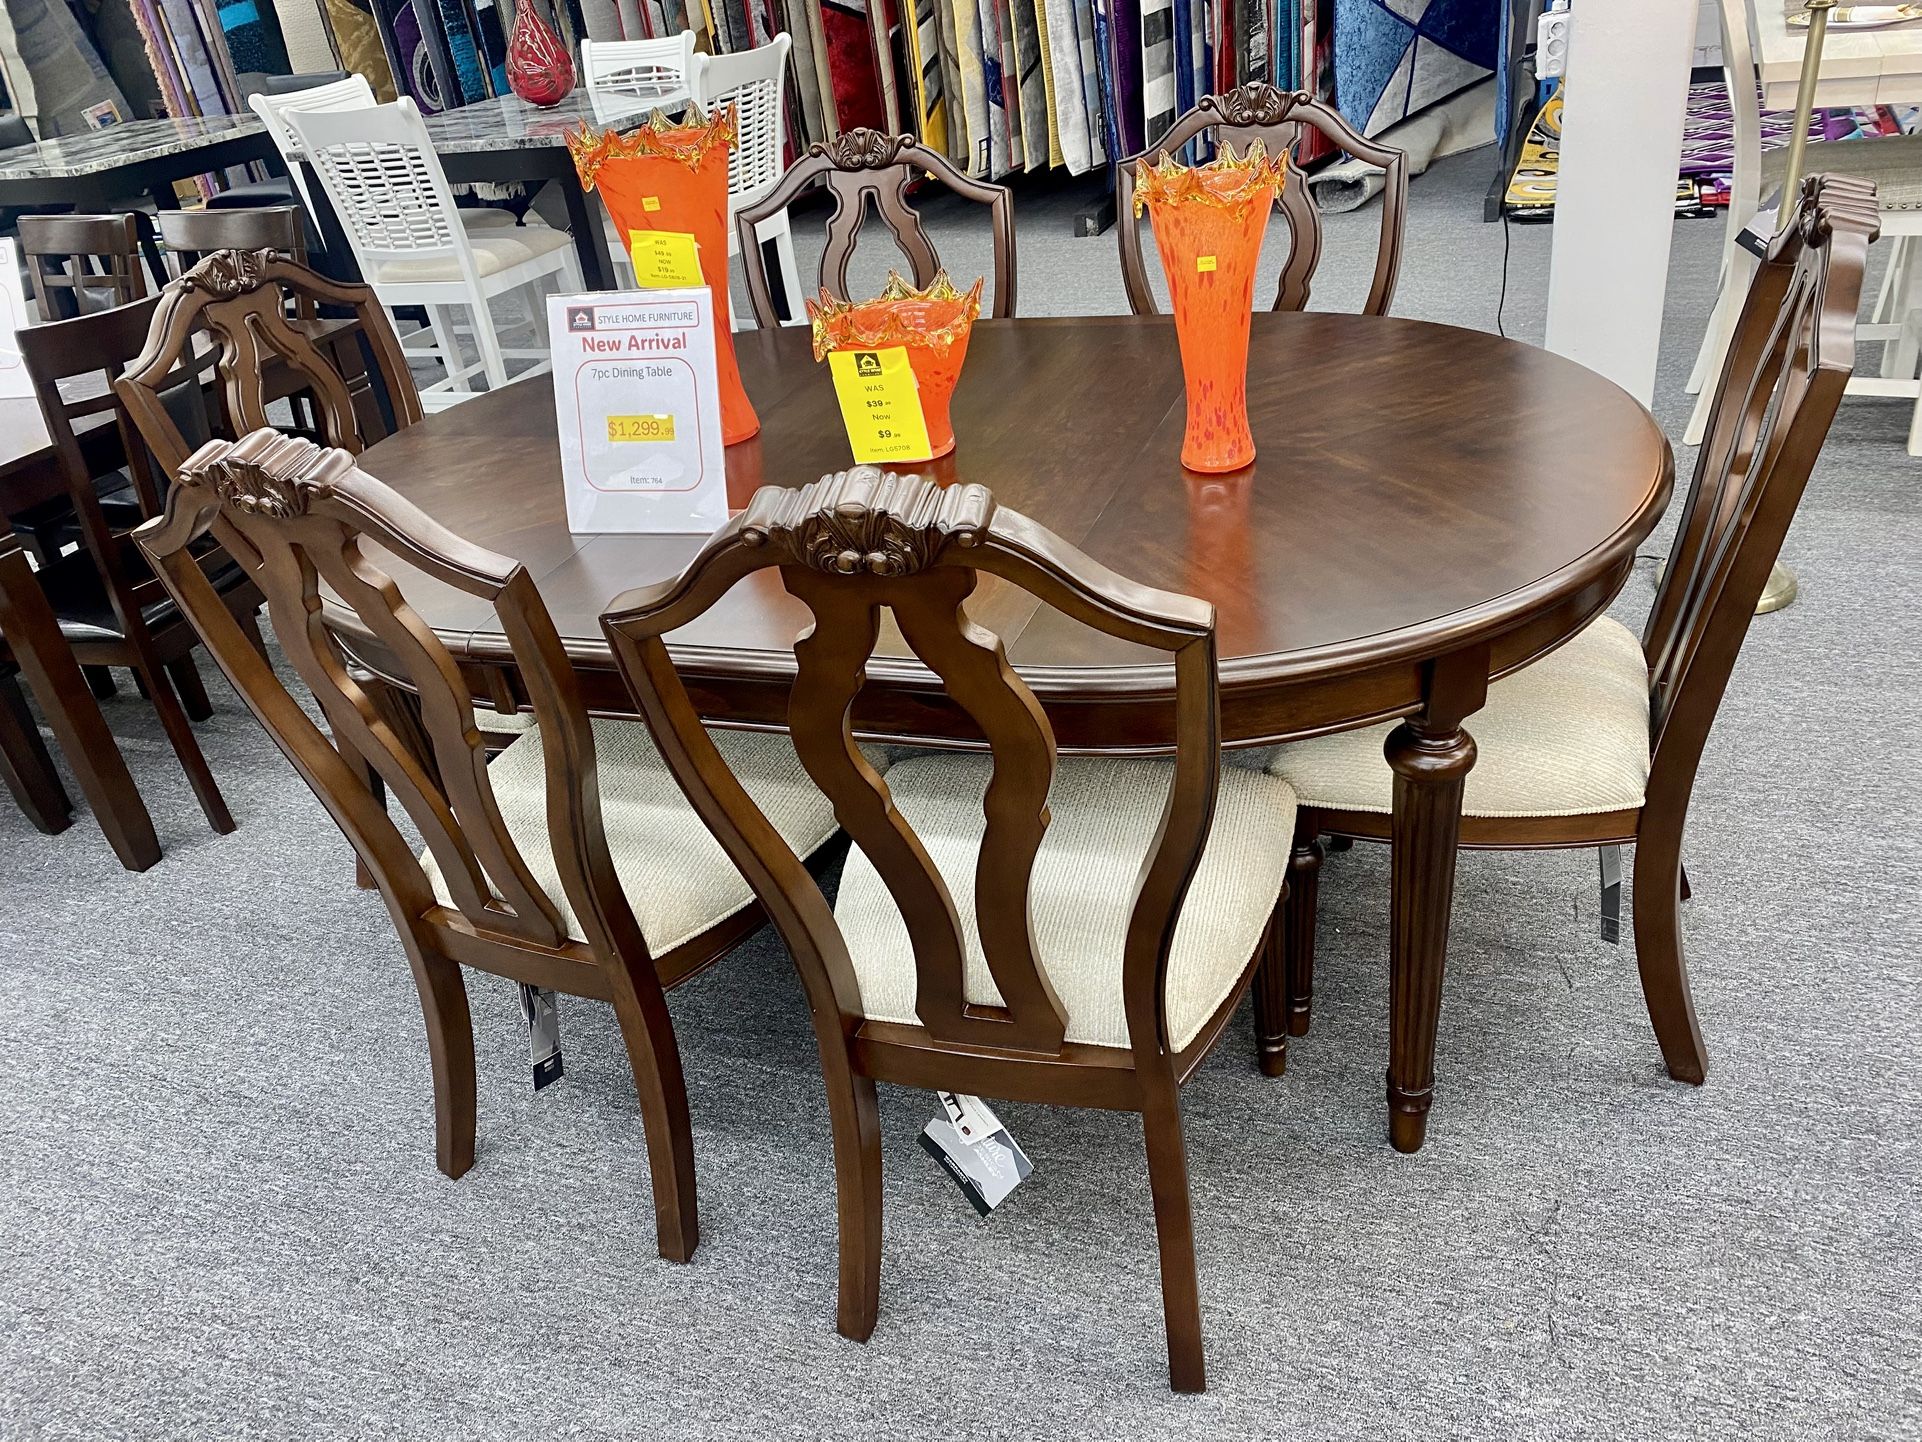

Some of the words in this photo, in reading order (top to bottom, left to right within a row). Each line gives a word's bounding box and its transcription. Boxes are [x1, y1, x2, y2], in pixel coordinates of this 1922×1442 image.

[598, 314, 620, 325] STYLE
[622, 313, 647, 324] HOME
[648, 311, 693, 322] FURNITURE
[582, 336, 622, 352] New
[627, 332, 687, 351] Arrival
[592, 368, 610, 380] 7pc
[612, 367, 644, 380] Dining
[645, 366, 672, 377] Table
[865, 384, 884, 392] WAS
[608, 420, 674, 438] $1,299.99
[630, 476, 649, 484] Item:
